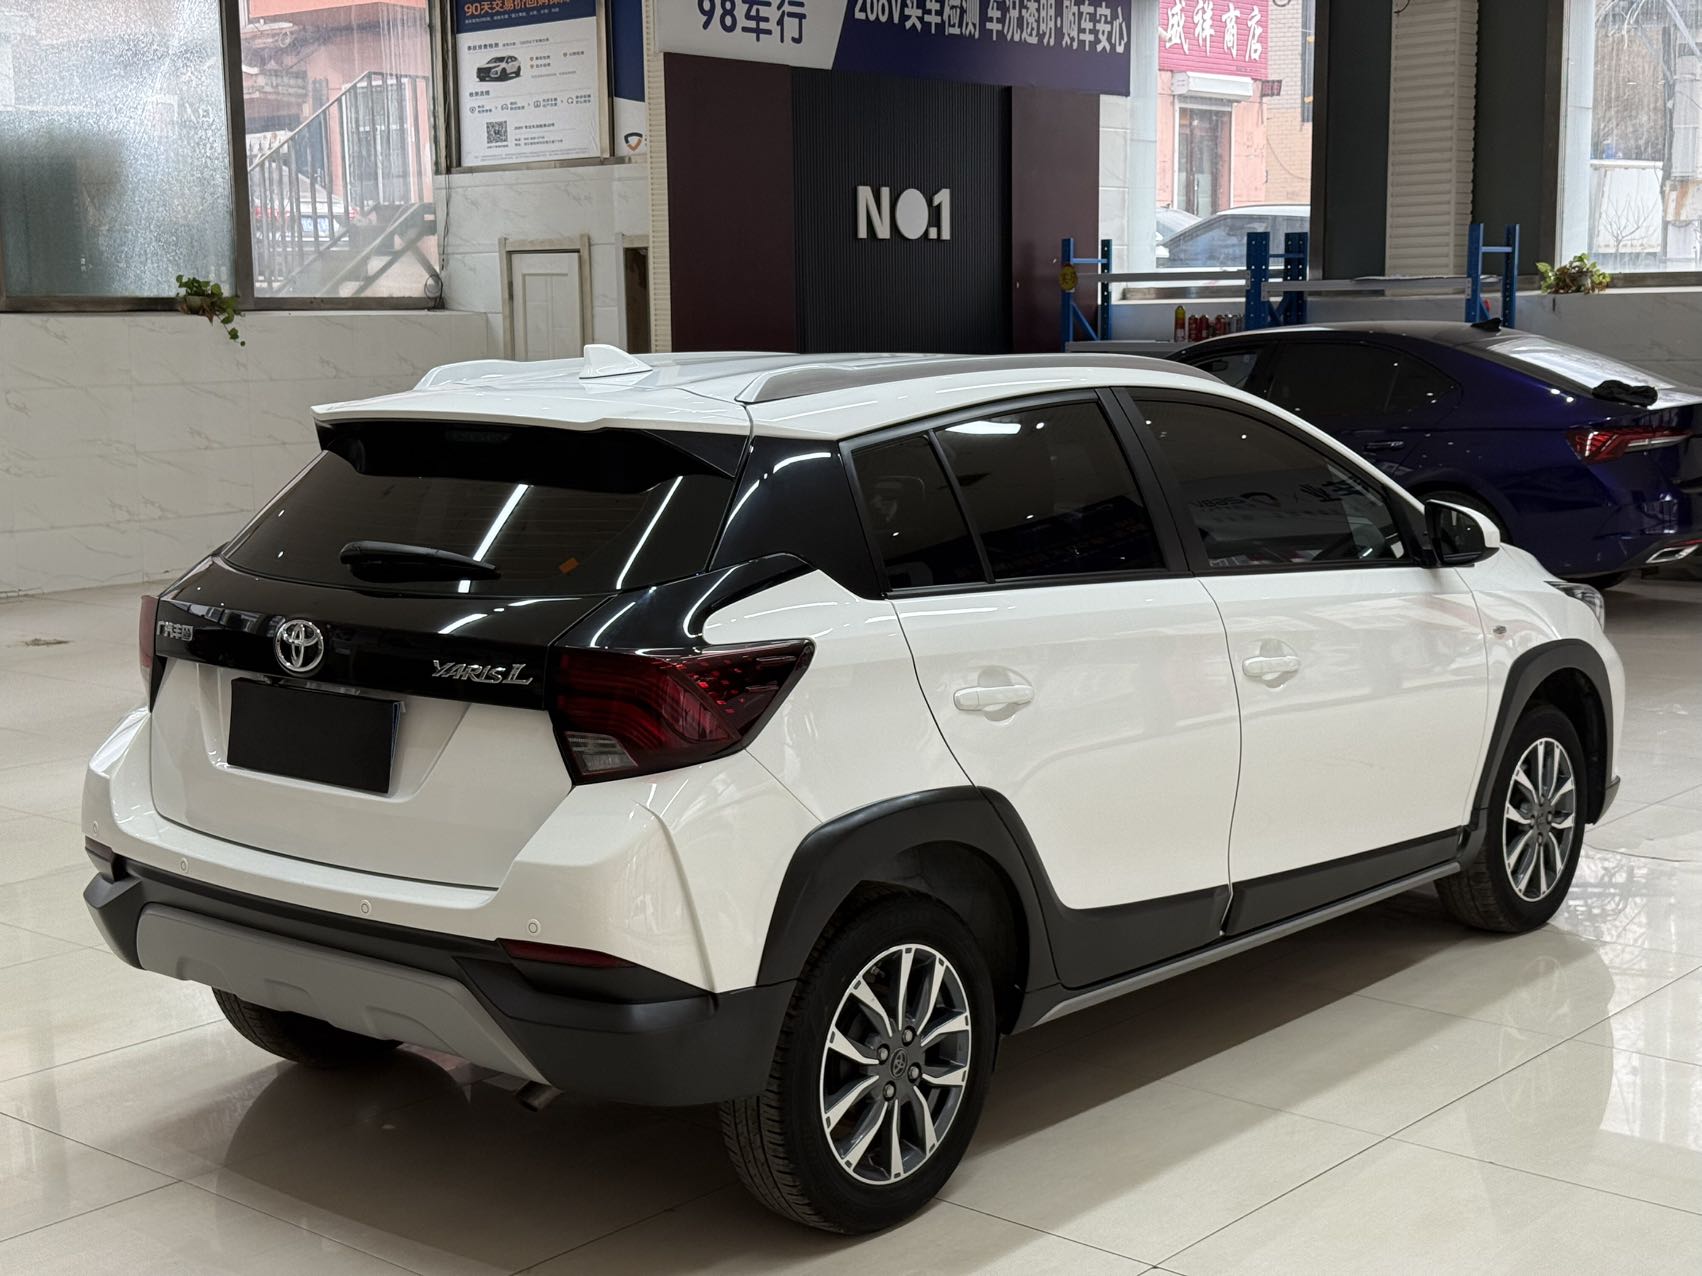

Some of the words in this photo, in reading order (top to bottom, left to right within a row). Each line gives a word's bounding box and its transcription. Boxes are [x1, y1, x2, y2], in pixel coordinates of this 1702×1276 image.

[697, 0, 807, 44] 98车行
[857, 185, 951, 240] NO.1
[432, 660, 503, 683] YARIS
[502, 663, 533, 685] L
